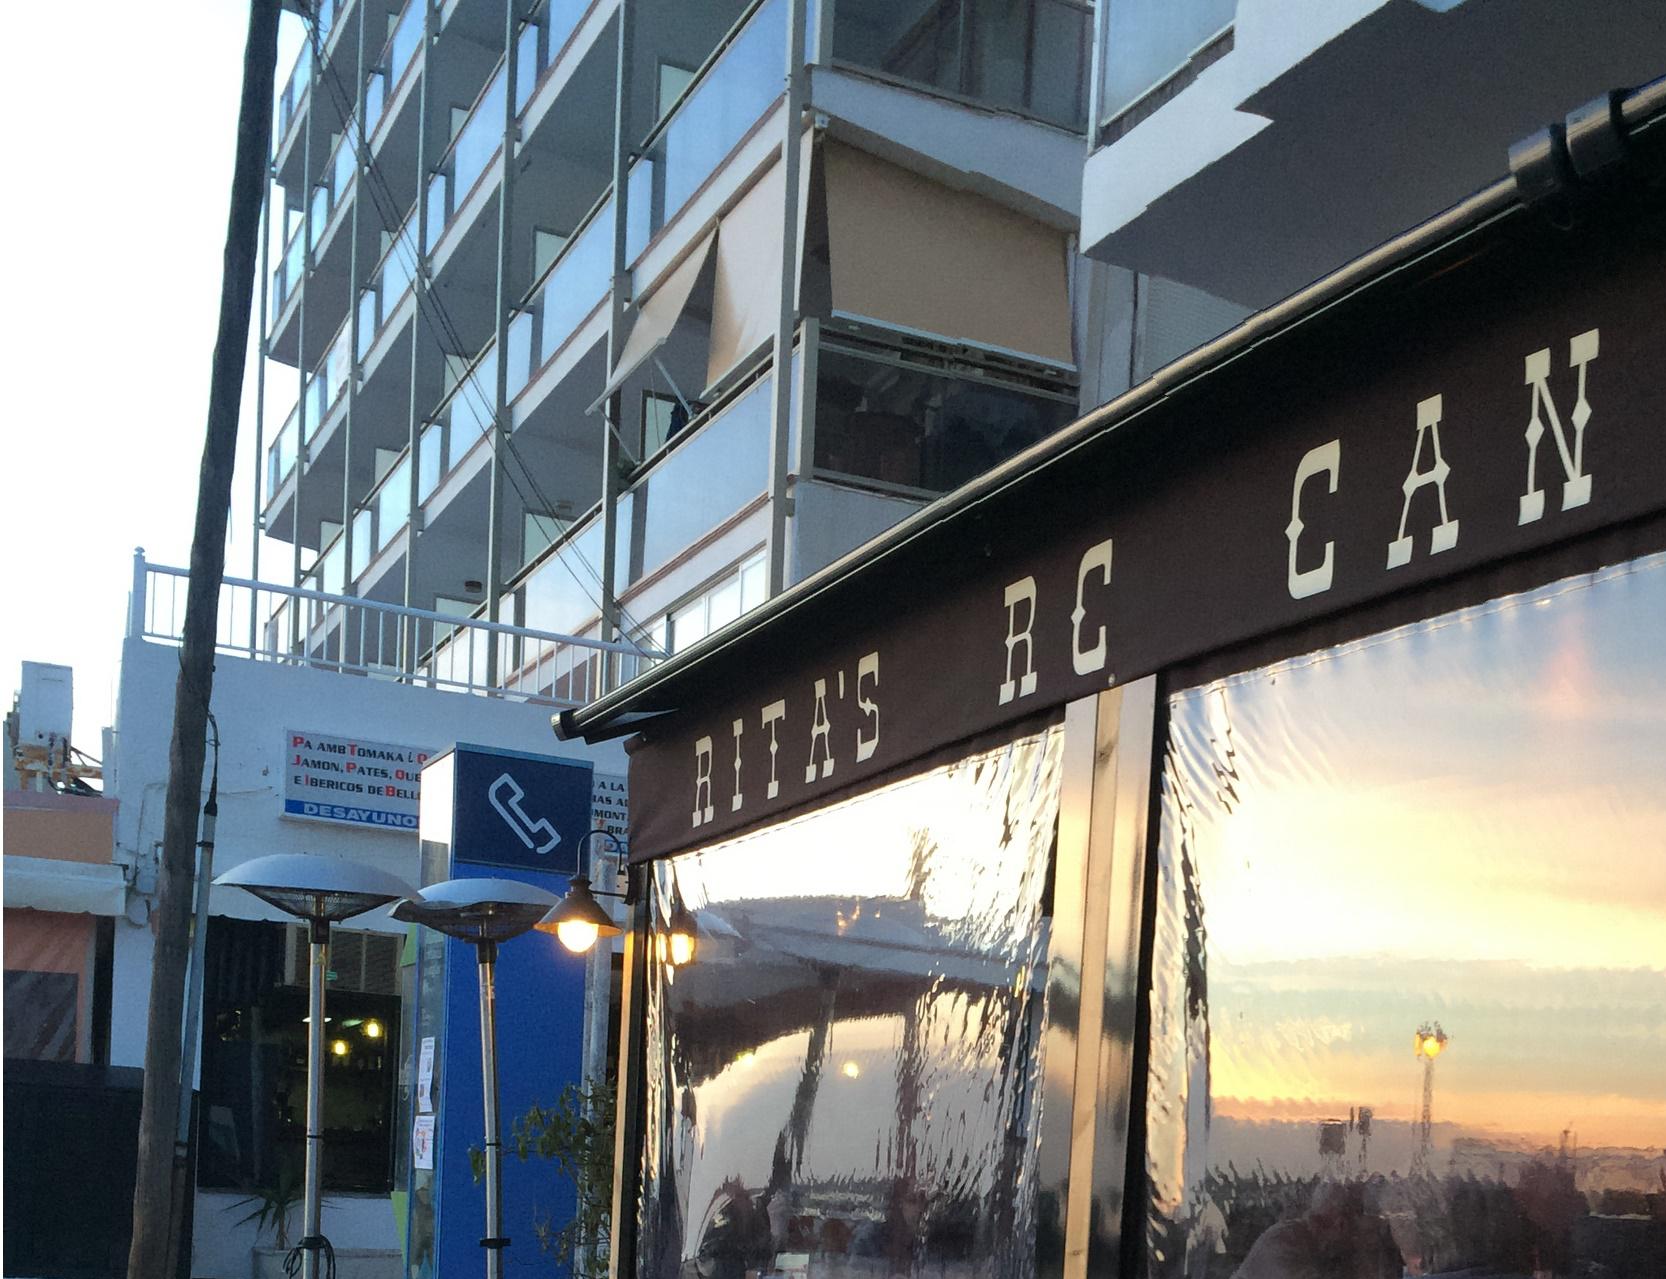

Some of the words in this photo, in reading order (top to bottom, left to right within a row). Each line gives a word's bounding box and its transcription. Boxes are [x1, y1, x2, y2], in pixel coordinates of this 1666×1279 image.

[692, 651, 880, 828] RITA'S
[998, 538, 1113, 706] RC
[292, 736, 313, 750] PA
[317, 742, 346, 754] AMB
[347, 744, 404, 763] TOMAKA
[294, 775, 302, 785] E
[304, 773, 363, 793] IBERICOS
[367, 785, 384, 796] DE
[303, 803, 420, 827] DESAYUNO
